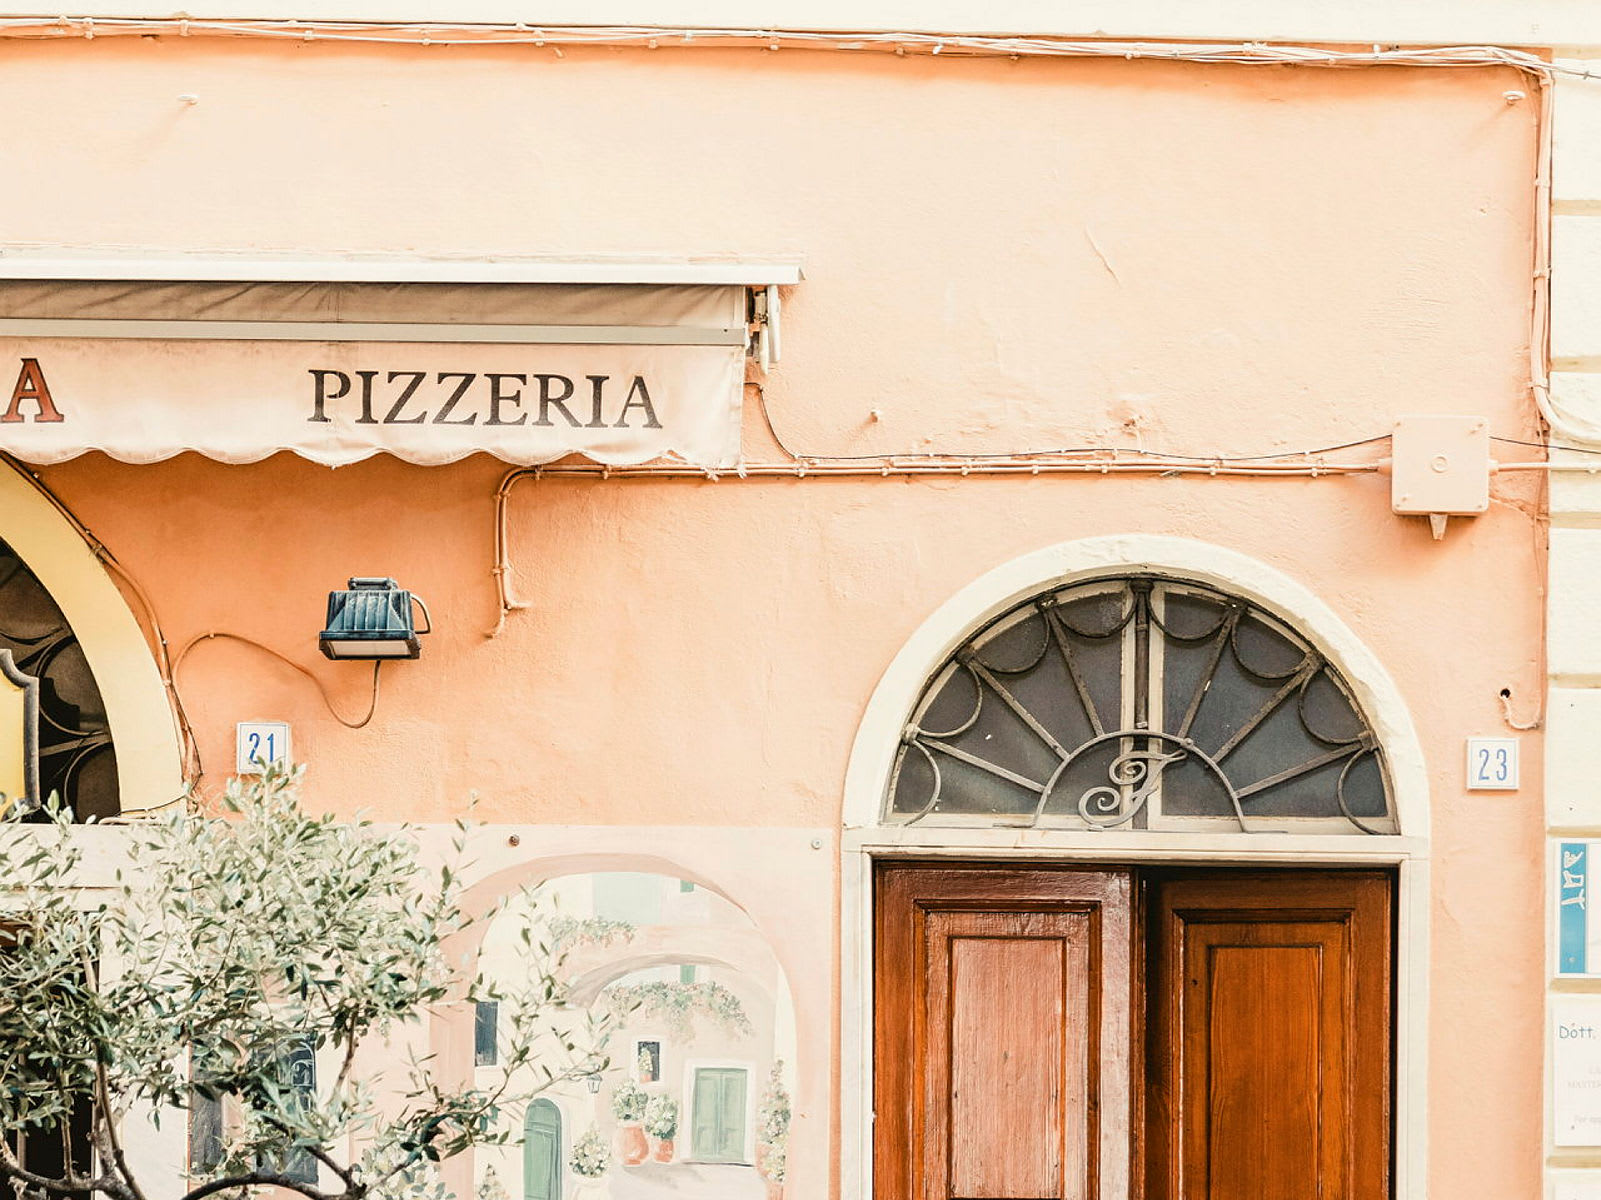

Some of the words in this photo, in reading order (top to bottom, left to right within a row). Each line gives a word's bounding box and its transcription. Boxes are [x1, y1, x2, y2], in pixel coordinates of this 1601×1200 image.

[0, 357, 65, 423] A
[307, 368, 664, 430] PIZZERIA
[248, 732, 275, 765] 21
[1477, 748, 1508, 782] 23
